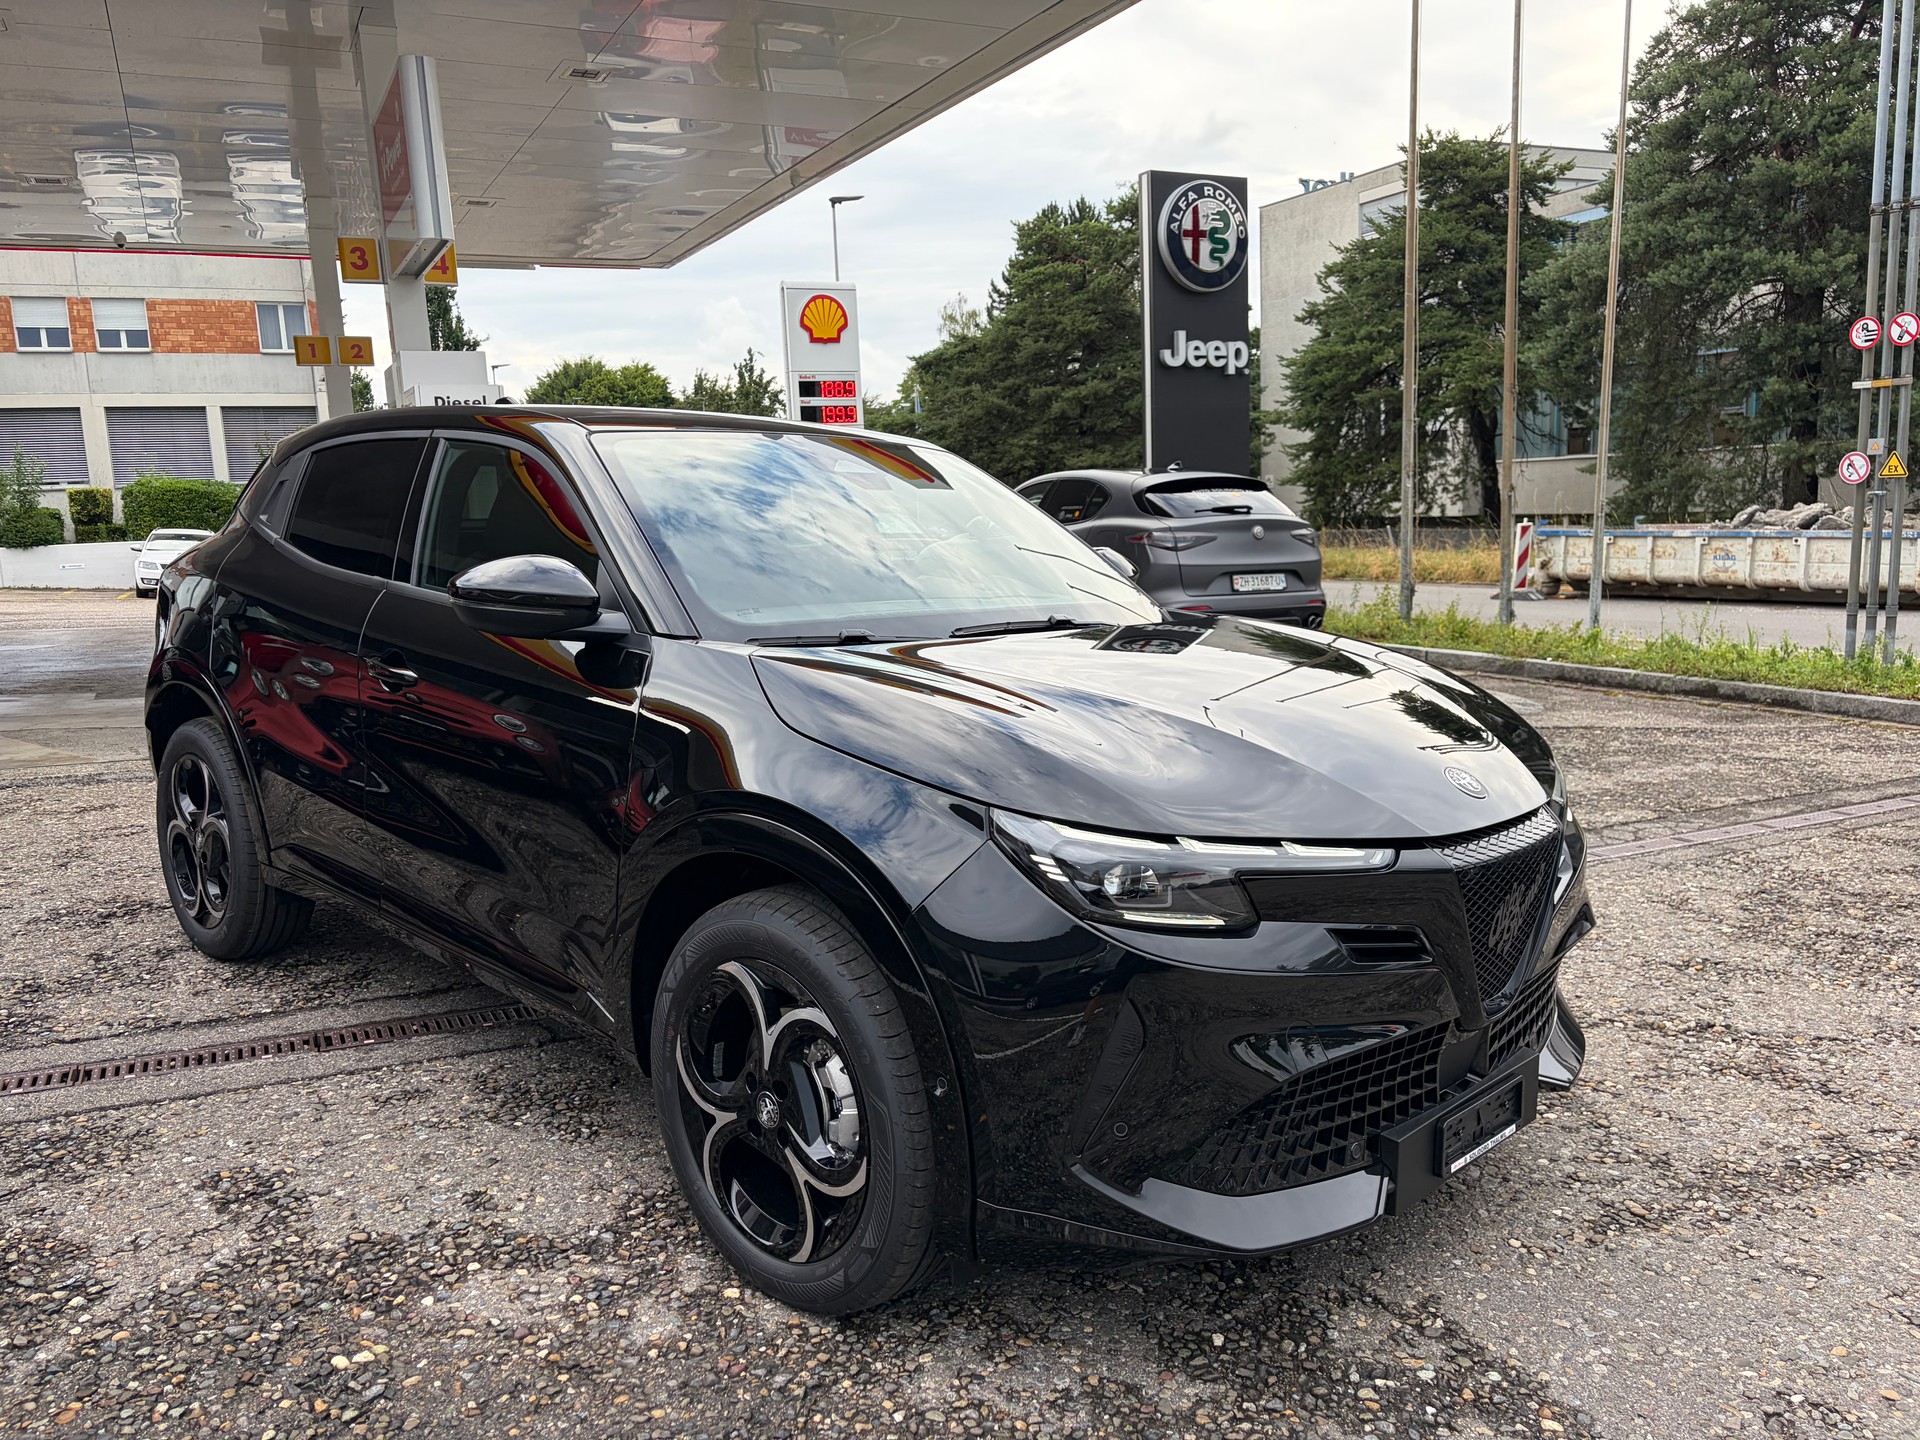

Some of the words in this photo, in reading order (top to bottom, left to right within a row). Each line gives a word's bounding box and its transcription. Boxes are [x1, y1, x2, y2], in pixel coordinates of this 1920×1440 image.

[1170, 191, 1198, 234] ALFA
[1204, 186, 1246, 239] ROMEO
[349, 246, 369, 270] 3
[431, 250, 449, 274] 4
[308, 343, 317, 358] 1
[350, 344, 364, 358] 2
[1159, 329, 1250, 375] Jeep
[820, 381, 856, 398] 188.9
[434, 395, 487, 406] Diesel
[821, 406, 857, 423] 199.9
[1888, 465, 1899, 473] EX
